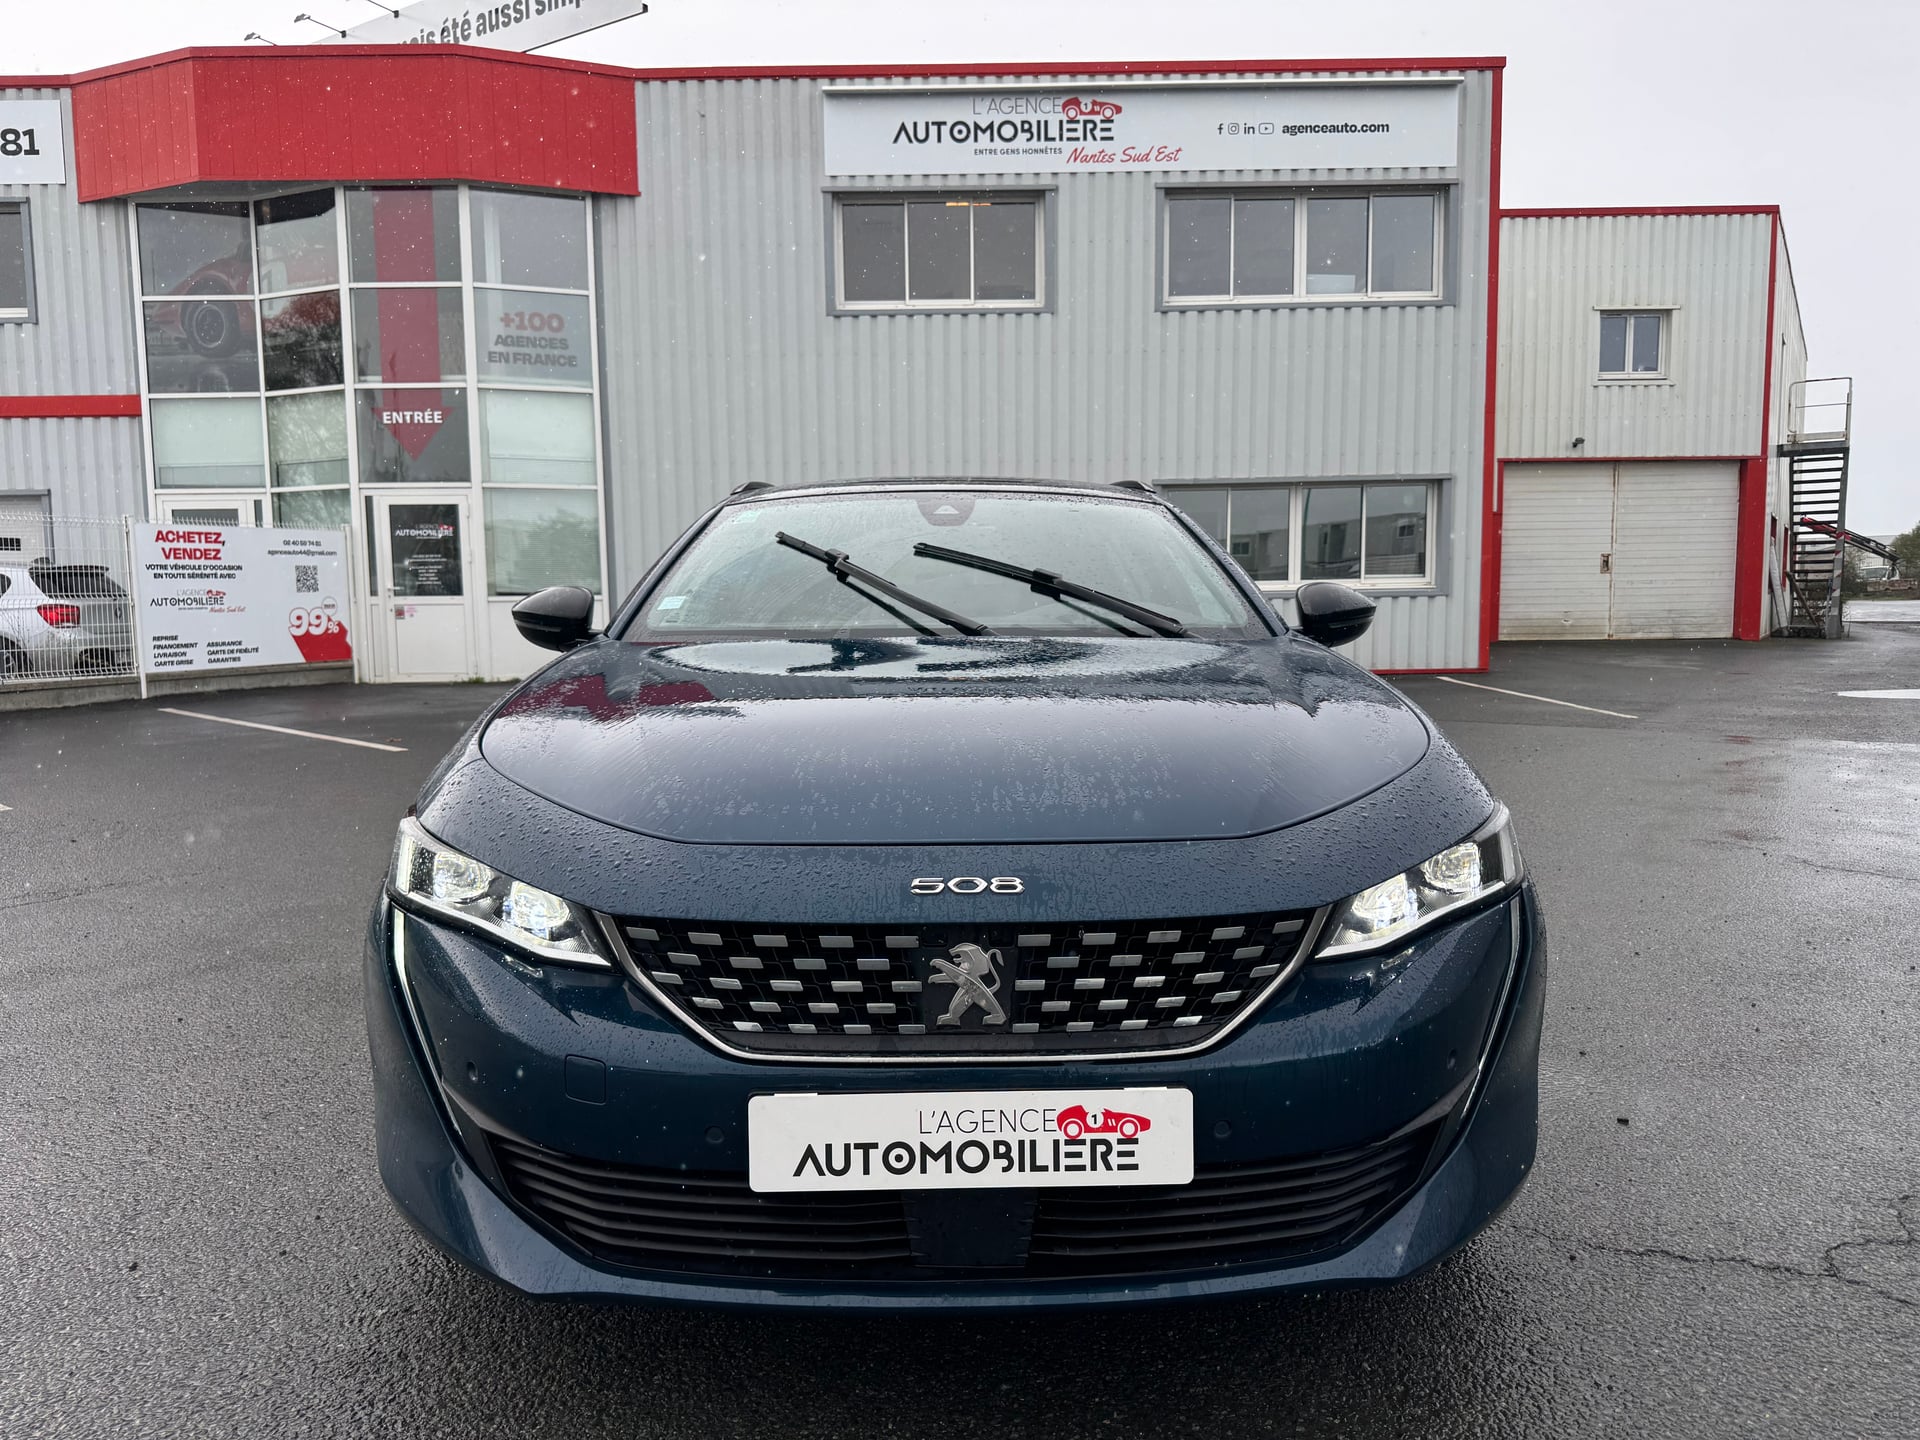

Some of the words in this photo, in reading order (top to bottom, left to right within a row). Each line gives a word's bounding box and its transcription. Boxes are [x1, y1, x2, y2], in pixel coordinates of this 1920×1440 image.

[440, 10, 472, 44] été
[476, 0, 531, 37] aussi
[972, 97, 1062, 115] L'AGENCE
[1282, 122, 1390, 136] agenceauto.com
[0, 128, 40, 156] 81
[974, 148, 998, 156] ENTRE
[1000, 147, 1021, 155] GENS
[1022, 146, 1063, 155] HONNÊTES
[1066, 147, 1115, 165] Nantes
[1120, 146, 1152, 163] Sud
[1154, 146, 1183, 163] Est
[500, 312, 565, 333] +100
[494, 334, 569, 350] AGENCES
[487, 351, 511, 364] EN
[512, 352, 578, 367] FRANCE
[382, 408, 443, 424] ENTRÉE
[161, 547, 222, 560] VENDEZ
[169, 563, 202, 571] VÉHICULE
[153, 642, 198, 650] FINANCEMENT
[236, 646, 259, 654] FIDÉLITÉ
[153, 651, 187, 659] LIVRAISON
[208, 656, 241, 664] GARANTIES
[910, 876, 1025, 894] 508
[918, 1108, 1058, 1135] L'AGENCE
